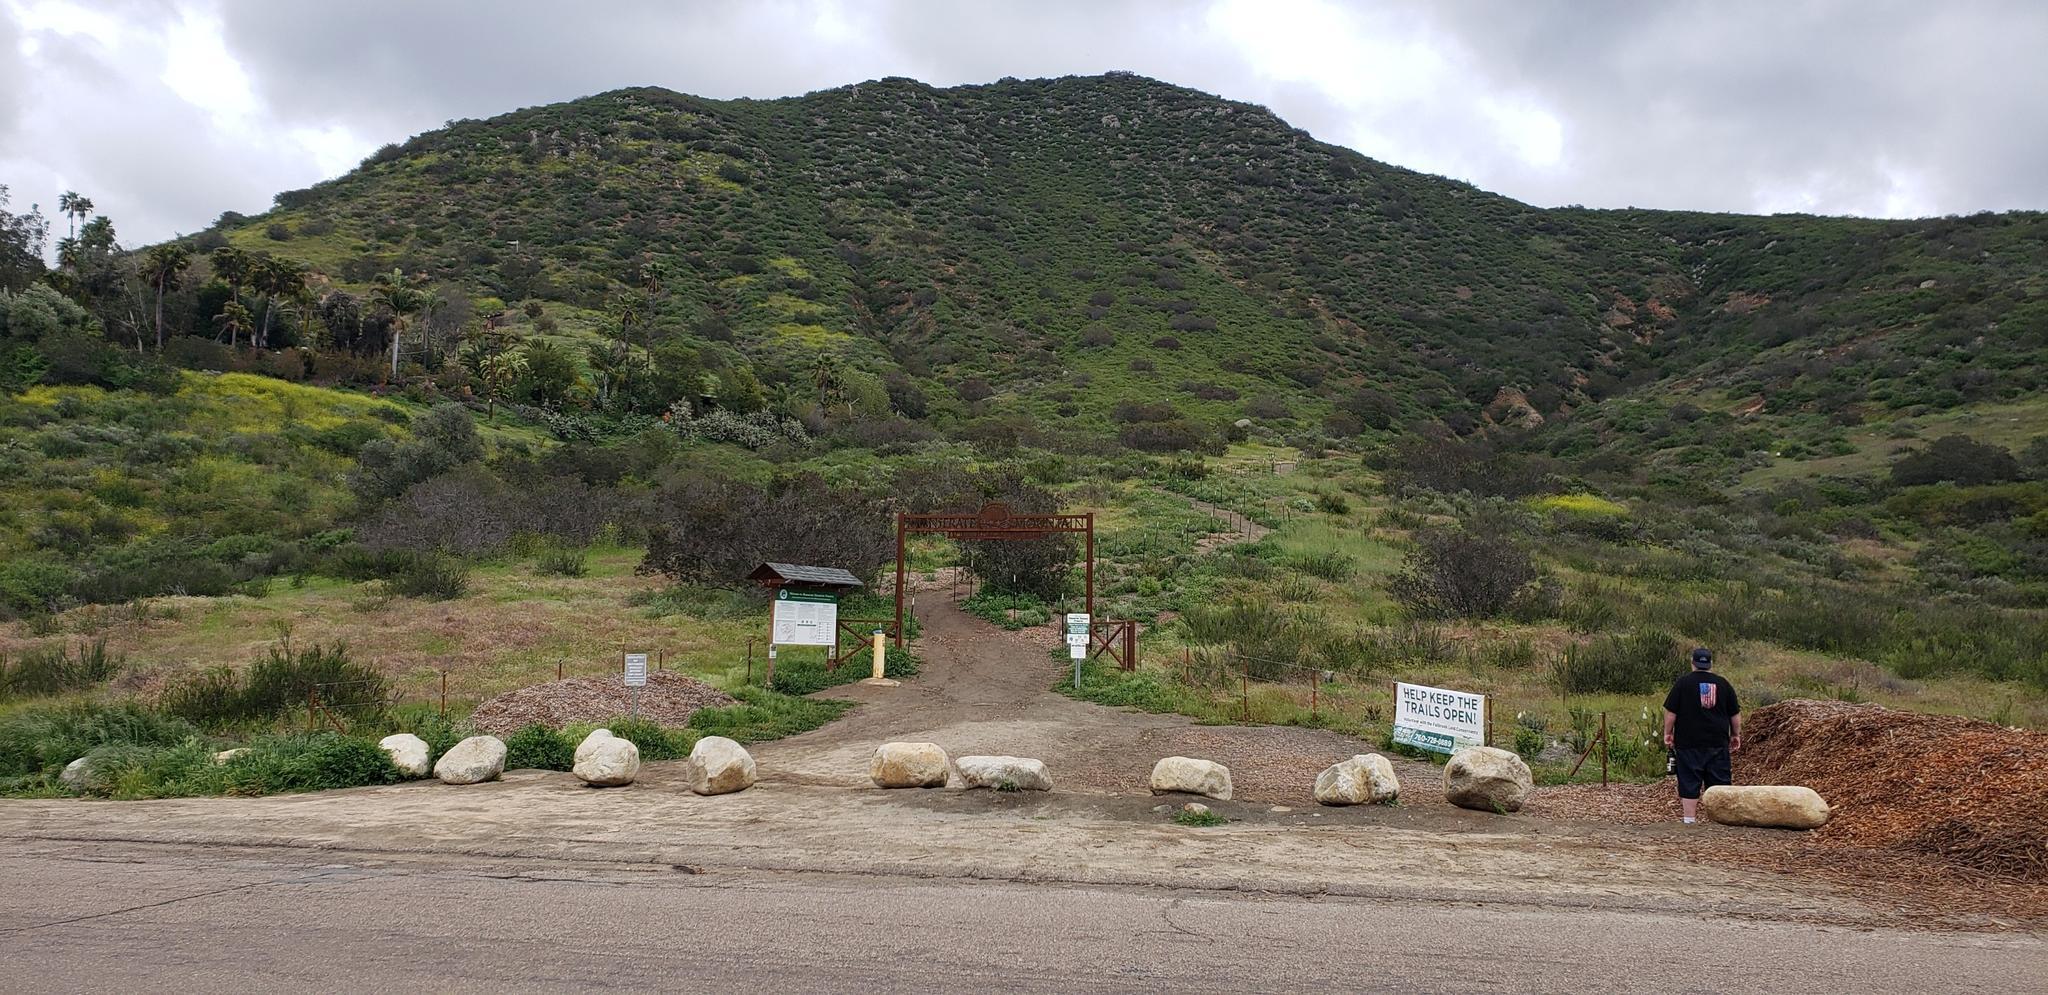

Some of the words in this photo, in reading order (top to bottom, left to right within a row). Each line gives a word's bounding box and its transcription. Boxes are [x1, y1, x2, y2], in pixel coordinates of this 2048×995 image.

[1403, 688, 1427, 701] HELP
[1430, 692, 1454, 706] KEEP
[1457, 697, 1477, 710] THE
[1404, 701, 1440, 718] TRAILS
[1443, 708, 1477, 725] OPEN!
